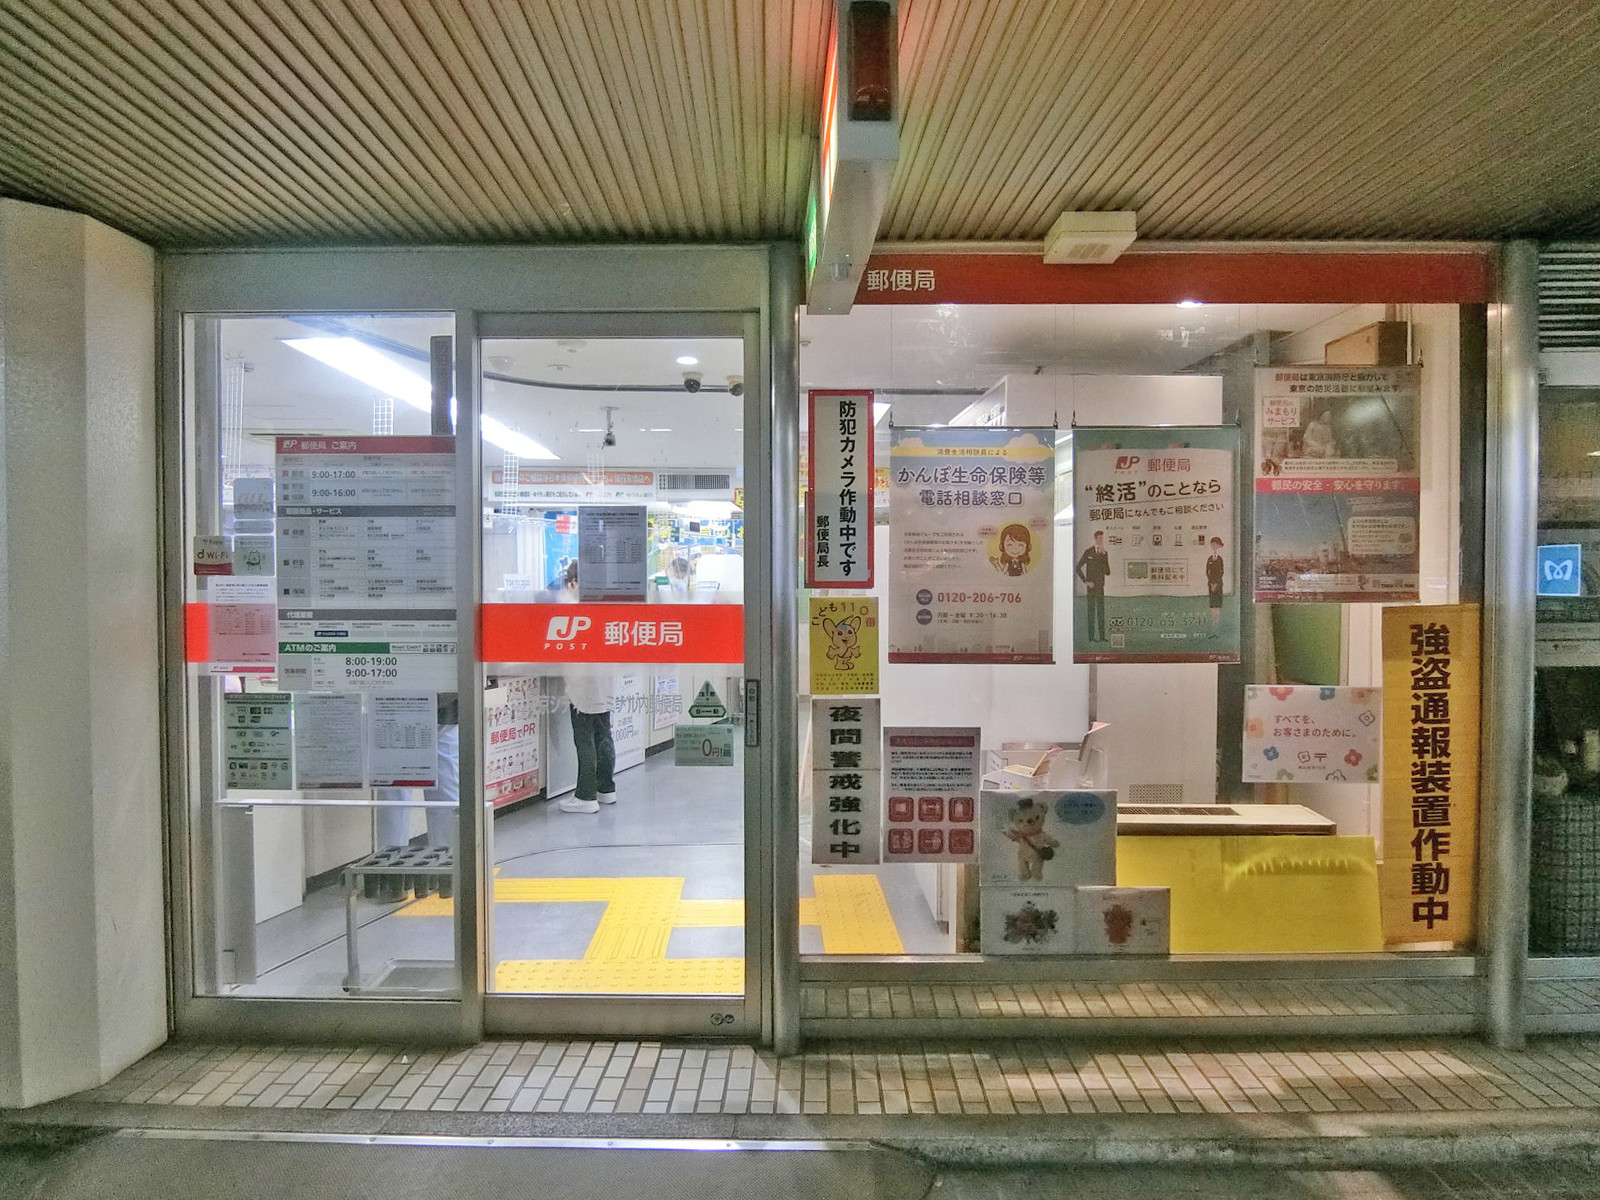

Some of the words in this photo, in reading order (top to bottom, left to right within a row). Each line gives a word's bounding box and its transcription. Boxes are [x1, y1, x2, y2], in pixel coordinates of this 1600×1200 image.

[866, 269, 936, 292] 郵便局
[1265, 407, 1297, 416] みまもり
[1266, 417, 1297, 425] サービス
[331, 441, 357, 450] ご案内
[1146, 458, 1191, 473] 郵便局
[311, 470, 356, 479] 9:00-17:00
[898, 465, 1046, 485] かんぽ生命保険等
[311, 488, 356, 497] 9:00-16:00
[838, 400, 857, 577] 防犯カメラ作動中です
[919, 490, 1022, 506] 電話相談窓口
[1088, 503, 1224, 522] 郵便局になんでもご相談ください
[816, 515, 830, 568] 郵便局長
[937, 592, 1022, 603] 0120-206-706
[546, 616, 592, 641] JP
[604, 621, 684, 646] 郵便局
[284, 643, 337, 653] ATMのご案内
[345, 656, 397, 666] 8:00-19:00
[345, 668, 398, 678] 9:00-17:00
[1274, 714, 1315, 724] すべてを、
[490, 722, 536, 745] 郵便局でPR
[1273, 728, 1357, 738] お客さまのために。
[829, 705, 862, 859] 夜間警戒強化中
[1410, 623, 1452, 929] 強盗通報装置作動中
